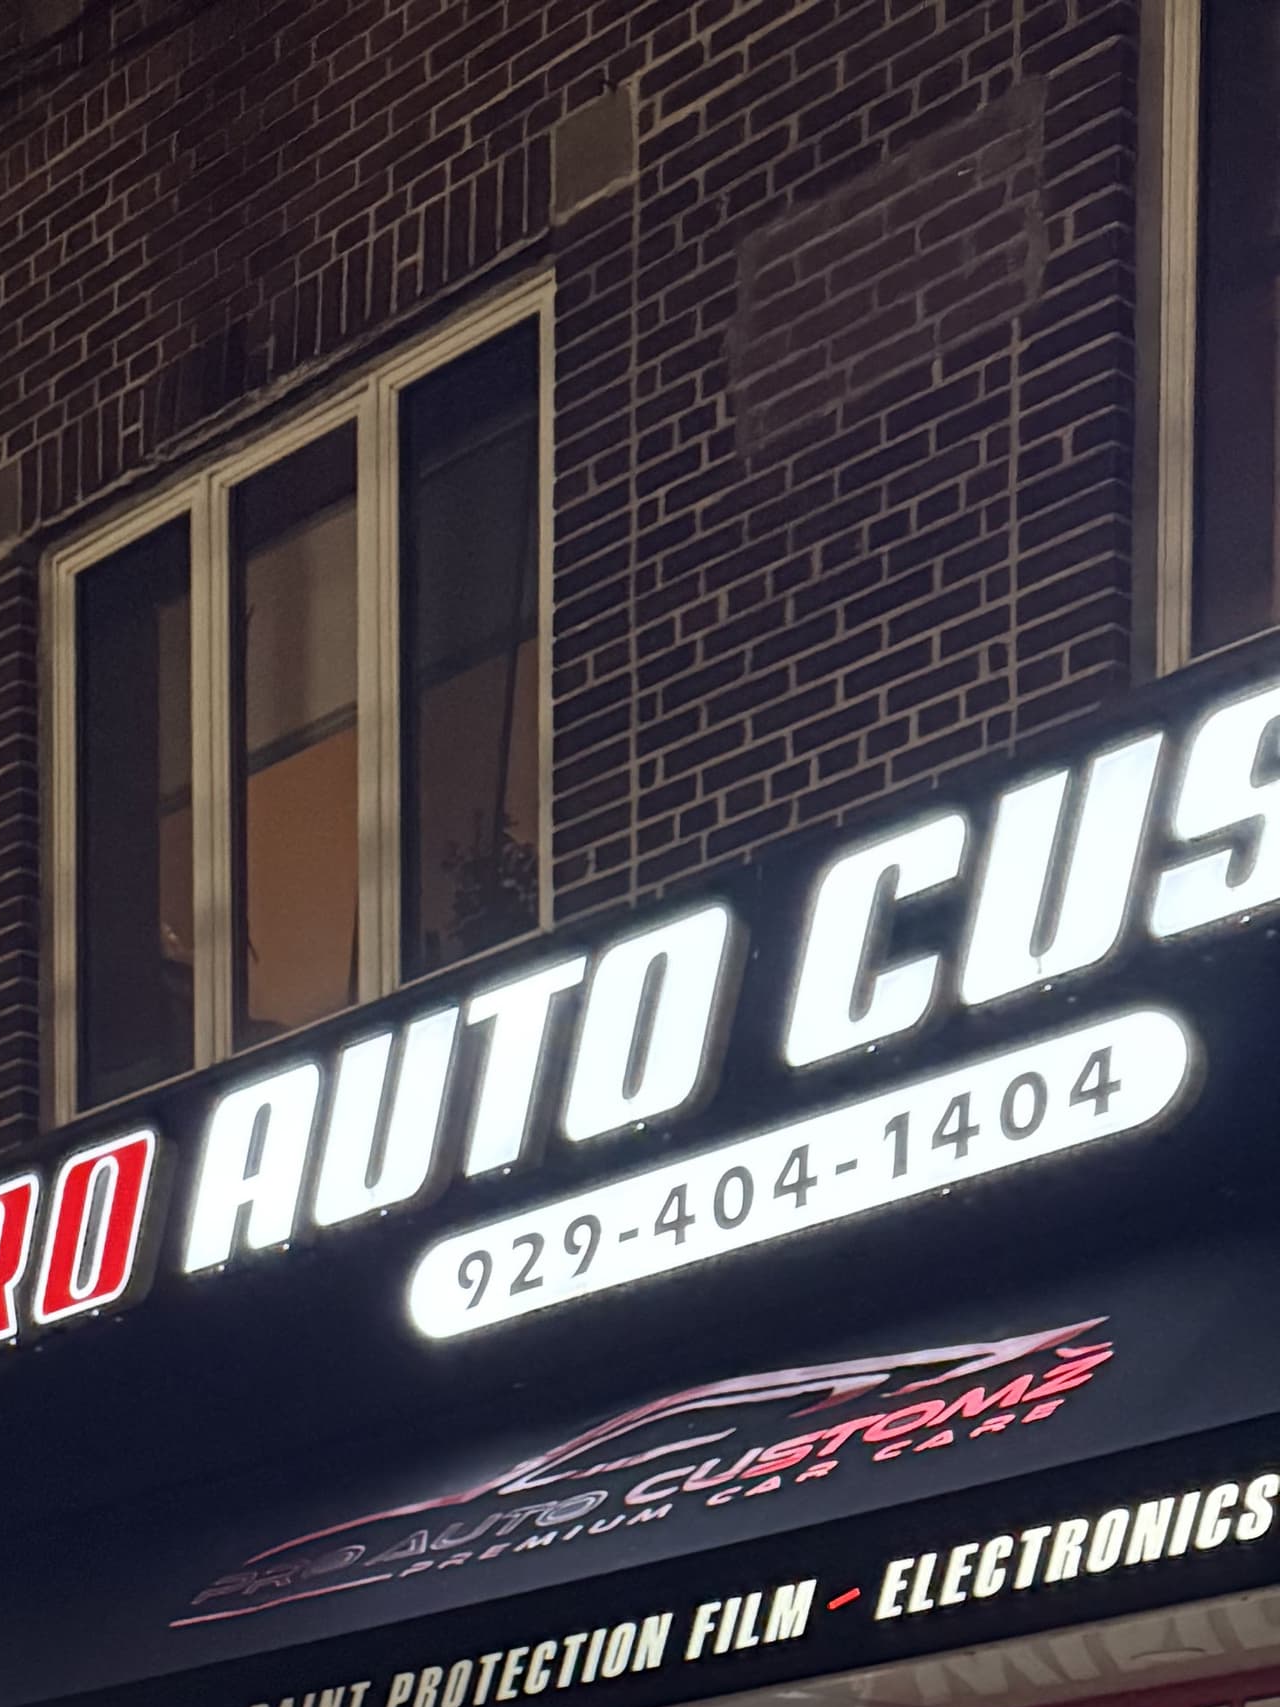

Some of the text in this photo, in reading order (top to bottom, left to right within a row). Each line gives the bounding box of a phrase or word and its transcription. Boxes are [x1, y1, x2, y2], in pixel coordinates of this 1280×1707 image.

[182, 904, 732, 1275] AUTO
[456, 1044, 1124, 1312] 929-404-1404
[192, 1340, 1116, 1606] PRO AUTO CUSTOMZ
[400, 1398, 1066, 1580] PREMIUM CAR CARE
[684, 1579, 817, 1661] FILM
[874, 1474, 1280, 1621] ELECTRONICS
